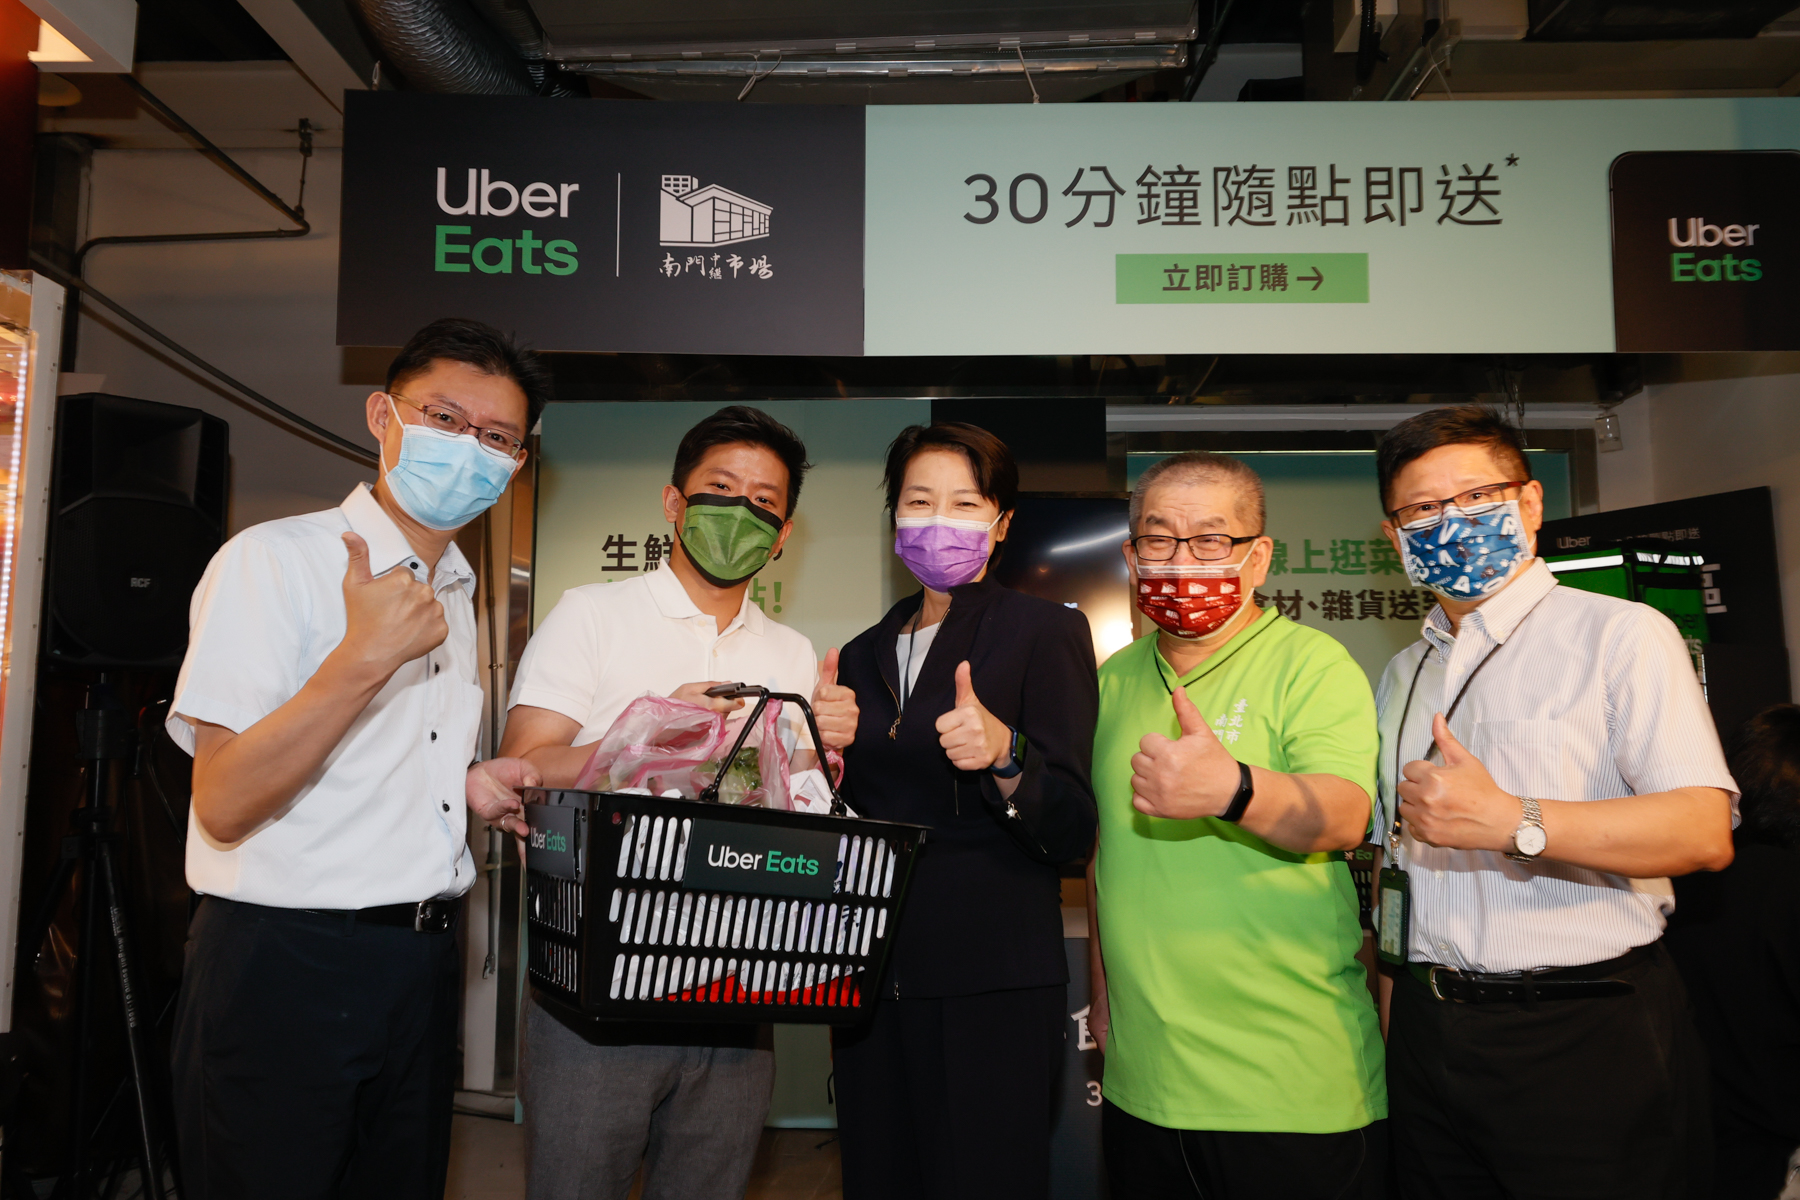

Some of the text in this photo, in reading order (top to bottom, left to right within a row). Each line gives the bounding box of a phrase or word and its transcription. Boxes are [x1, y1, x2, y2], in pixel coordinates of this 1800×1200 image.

[436, 167, 580, 218] Uber
[1668, 217, 1760, 248] Uber
[434, 224, 579, 276] Eats
[1162, 262, 1289, 292] 立即訂購
[1670, 252, 1763, 282] Eats
[1556, 536, 1592, 549] Uber
[530, 827, 567, 853] Uber Eats
[707, 844, 820, 876] Uber Eats
